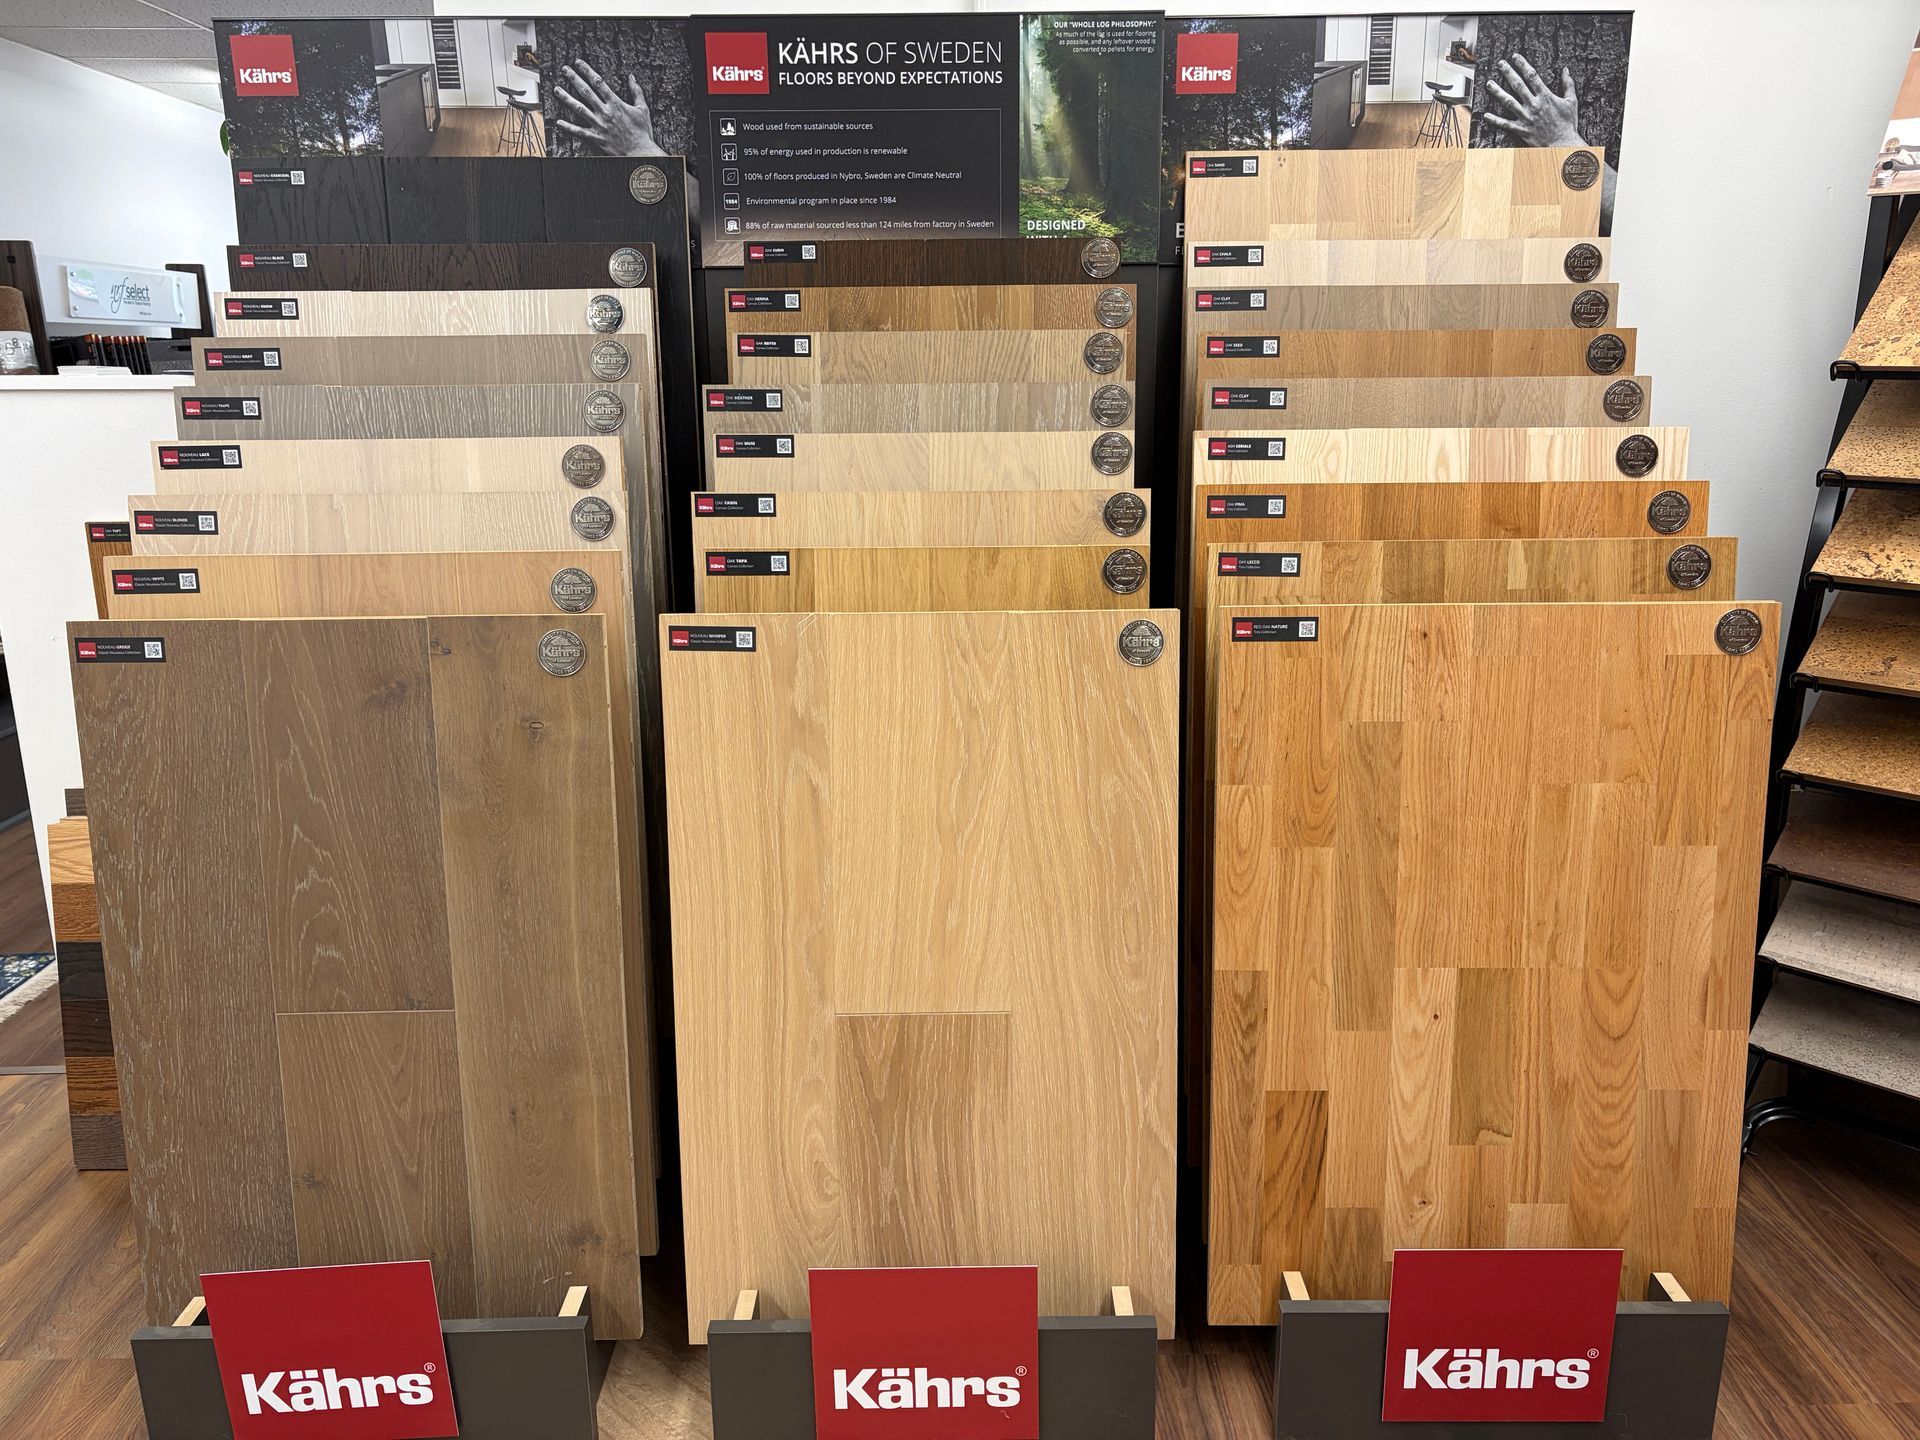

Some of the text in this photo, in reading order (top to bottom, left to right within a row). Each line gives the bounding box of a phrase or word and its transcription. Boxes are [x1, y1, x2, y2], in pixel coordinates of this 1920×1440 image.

[1135, 30, 1156, 38] flooring
[778, 38, 1002, 64] KÄHRS OF SWEDEN
[1108, 46, 1126, 55] pellets
[240, 68, 292, 85] Kährs
[712, 66, 764, 82] Kährs
[779, 70, 1003, 85] FLOORS BEYOND EXPECTATIONS
[1182, 66, 1231, 82] Kährs
[743, 122, 764, 130] Wood
[804, 122, 844, 130] sustainable
[760, 148, 768, 156] of
[770, 149, 794, 158] energy
[823, 148, 862, 156] production
[774, 172, 794, 180] floors
[796, 172, 830, 182] produced
[840, 172, 862, 182] Nybro,
[864, 172, 892, 180] Sweden
[799, 198, 830, 206] program
[840, 197, 858, 206] place
[932, 220, 957, 230] factory
[1027, 220, 1086, 231] DESIGNED
[126, 284, 150, 300] select
[588, 405, 621, 415] Kährs
[575, 512, 610, 524] Kährs
[554, 584, 591, 596] Kährs
[1122, 635, 1161, 648] Kährs
[542, 646, 580, 658] Kährs
[1403, 1348, 1590, 1390] Kährs
[240, 1367, 434, 1415] Kährs
[834, 1366, 1020, 1410] Kährs
